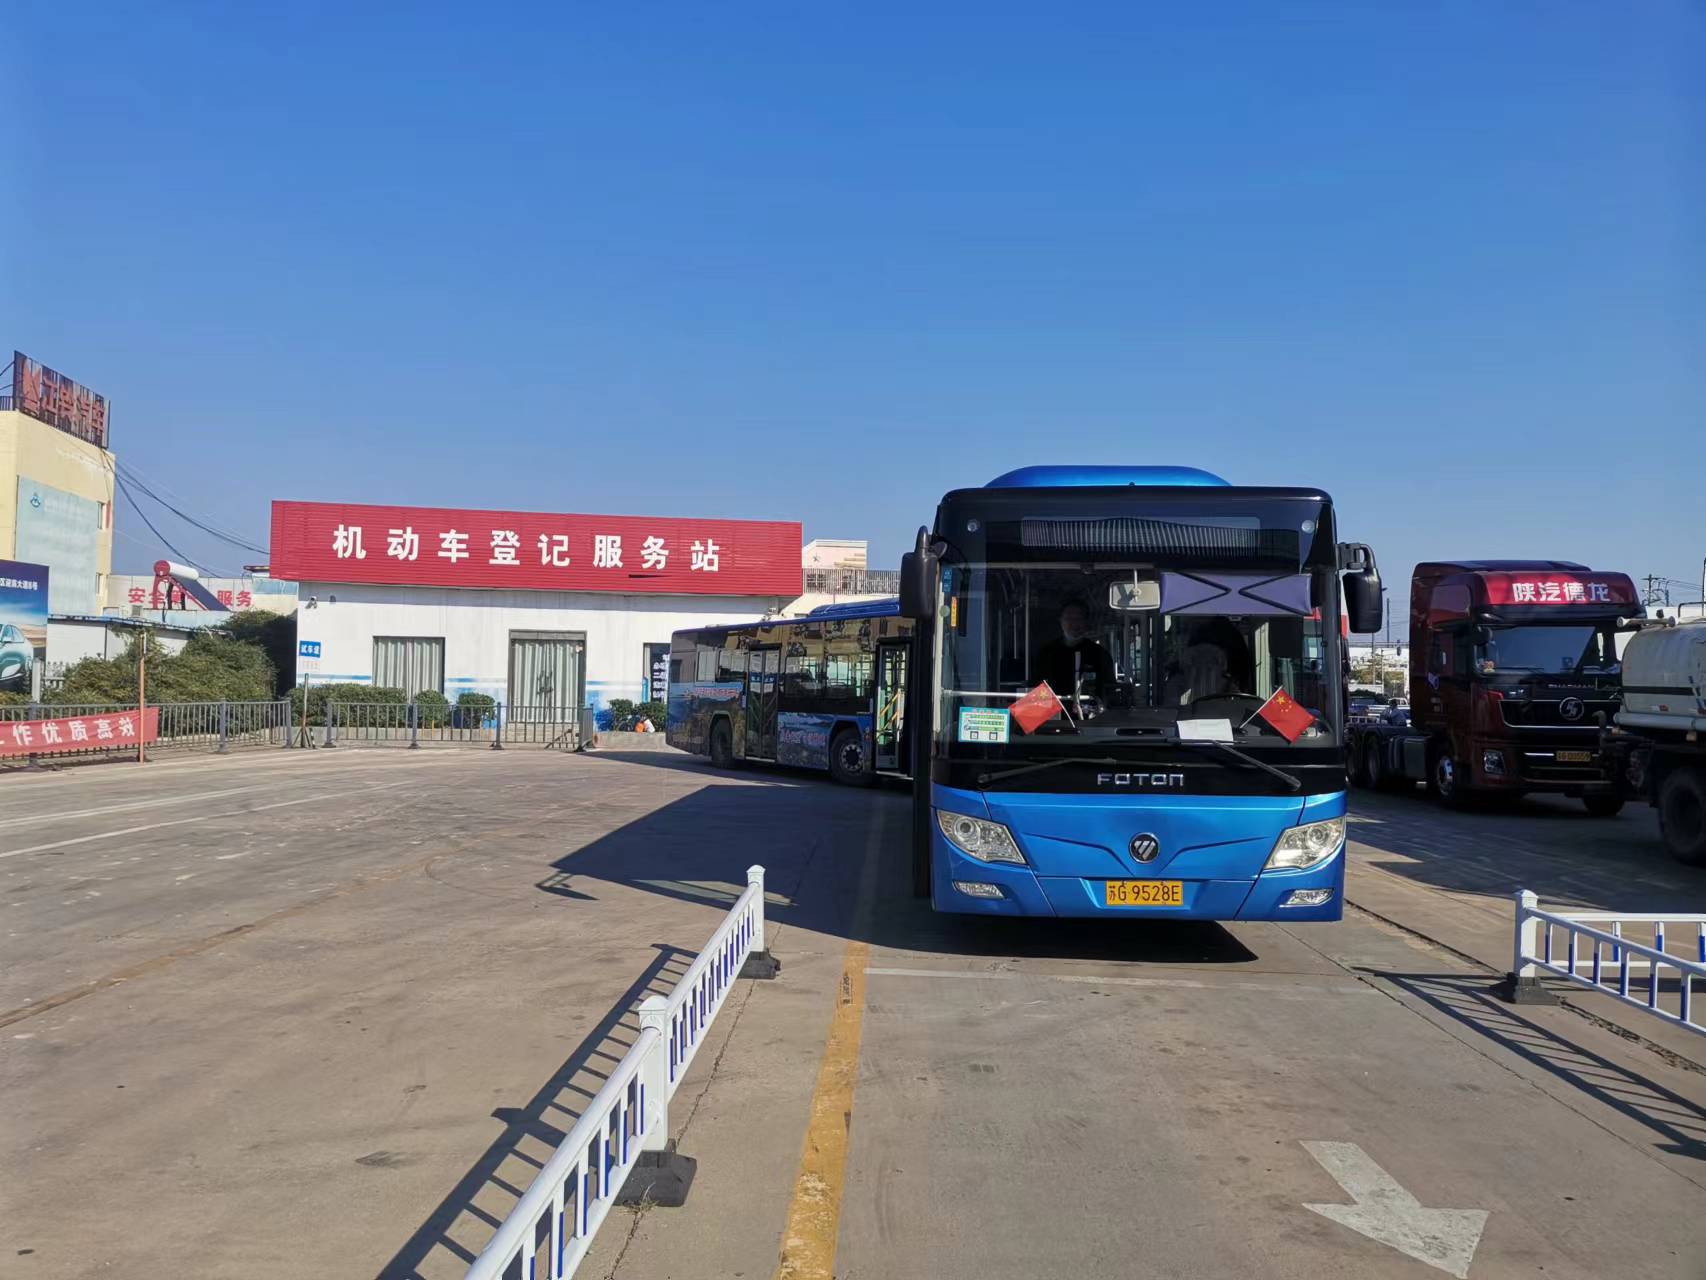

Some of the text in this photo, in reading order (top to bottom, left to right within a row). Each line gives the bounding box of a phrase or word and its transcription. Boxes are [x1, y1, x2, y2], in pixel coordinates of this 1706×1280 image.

[332, 524, 720, 572] 机动车登记服务站
[1512, 582, 1611, 602] 陕汽德龙
[0, 717, 135, 746] 作优质高效
[1097, 773, 1184, 786] FOTON
